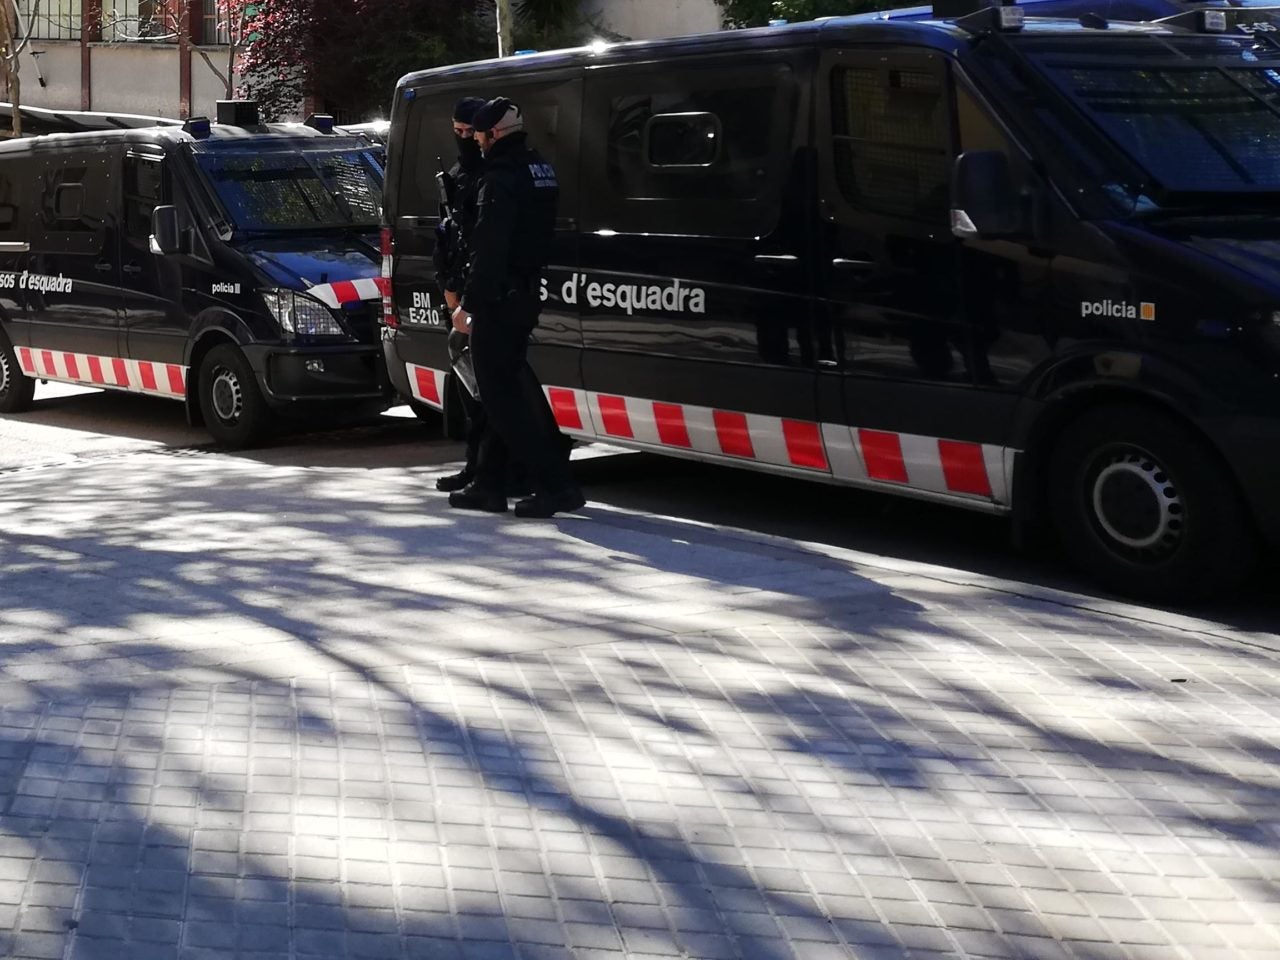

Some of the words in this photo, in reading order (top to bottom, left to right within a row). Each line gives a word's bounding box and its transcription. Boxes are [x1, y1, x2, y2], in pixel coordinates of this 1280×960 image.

[19, 270, 72, 295] d'esquadra
[212, 282, 234, 295] policia
[412, 291, 431, 308] BM
[561, 273, 706, 315] d'esquadra
[408, 307, 440, 326] E-210
[1081, 299, 1137, 319] policia
